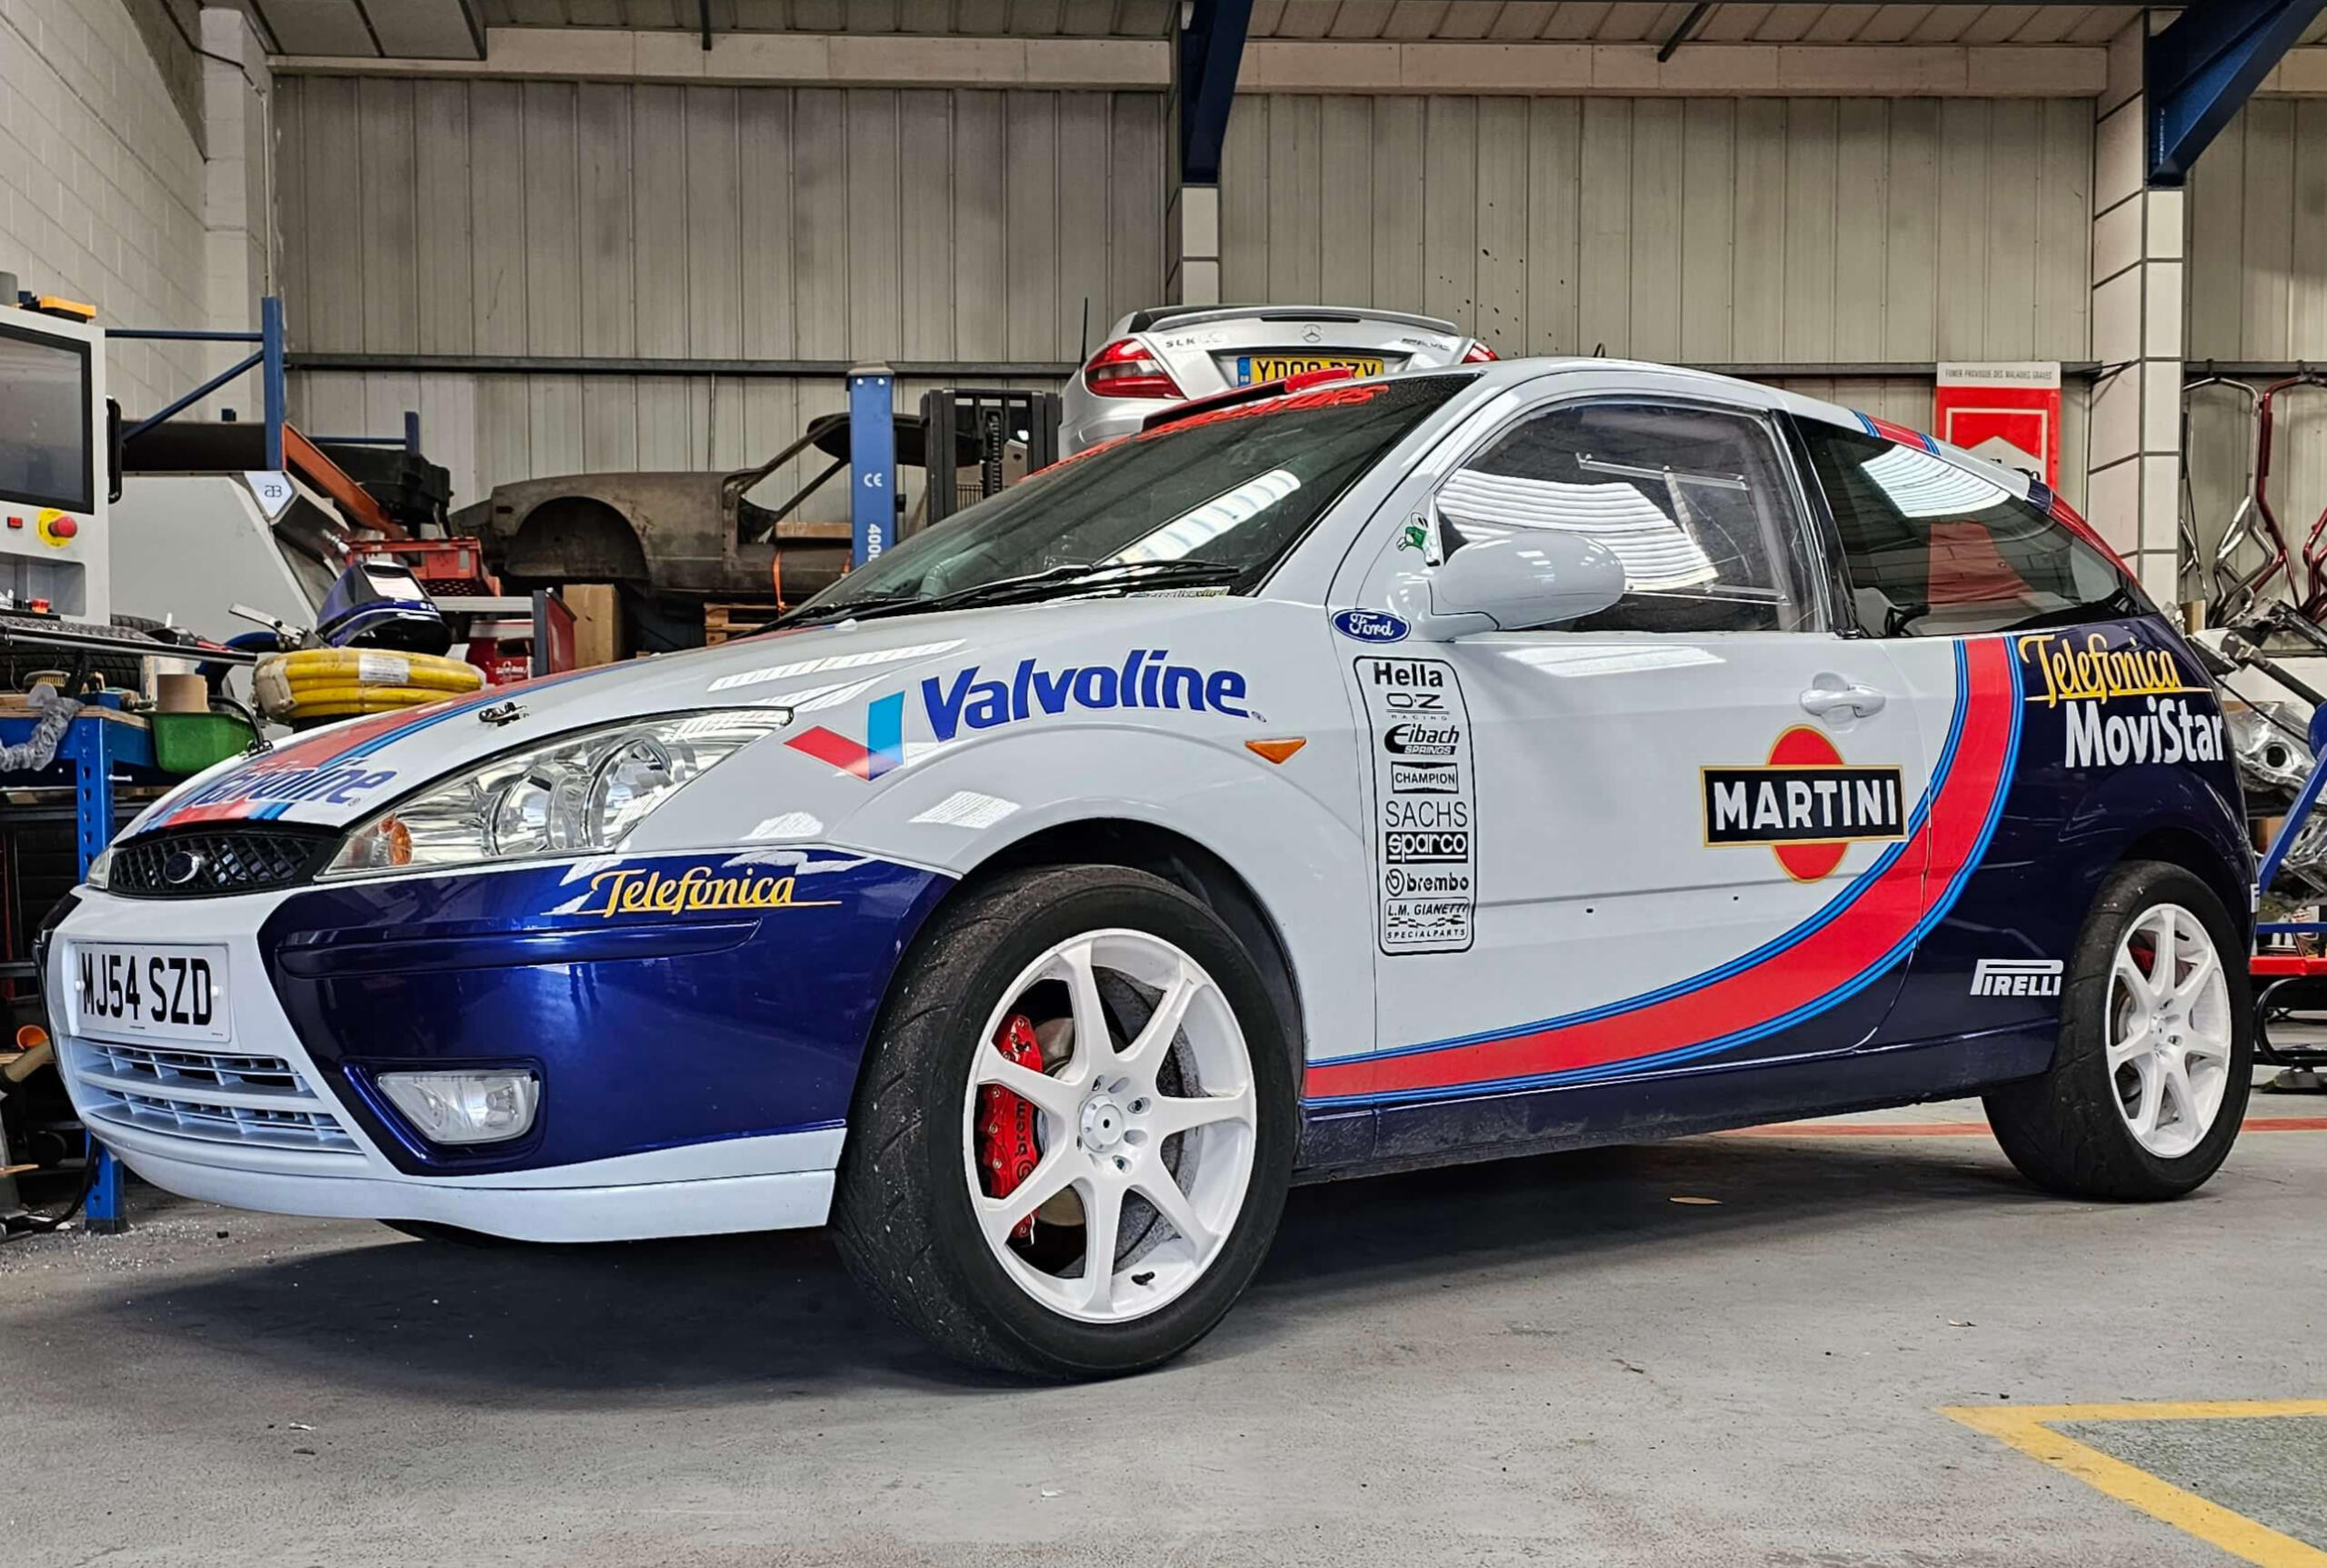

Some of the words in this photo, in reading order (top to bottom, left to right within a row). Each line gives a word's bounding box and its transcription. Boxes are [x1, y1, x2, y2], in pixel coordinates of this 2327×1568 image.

[1349, 613, 1394, 636] Ford
[1373, 662, 1443, 687] Hella
[2017, 633, 2182, 709] Telefonica
[921, 649, 1250, 743] Valvoline
[1384, 724, 1460, 753] Eibach
[2065, 695, 2224, 768] MoviStar
[1404, 745, 1452, 754] SPRINGS
[1395, 772, 1455, 784] CHAMPION
[1385, 801, 1468, 828] SACHS
[1713, 779, 1897, 831] MARTINI
[1387, 833, 1467, 863] sparco
[591, 867, 796, 918] Telefonica
[1406, 872, 1469, 892] brembo
[1388, 904, 1409, 917] L.M.
[82, 953, 141, 1020] MJ54
[148, 956, 213, 1025] SZD
[1970, 959, 2063, 996] PIRELLI
